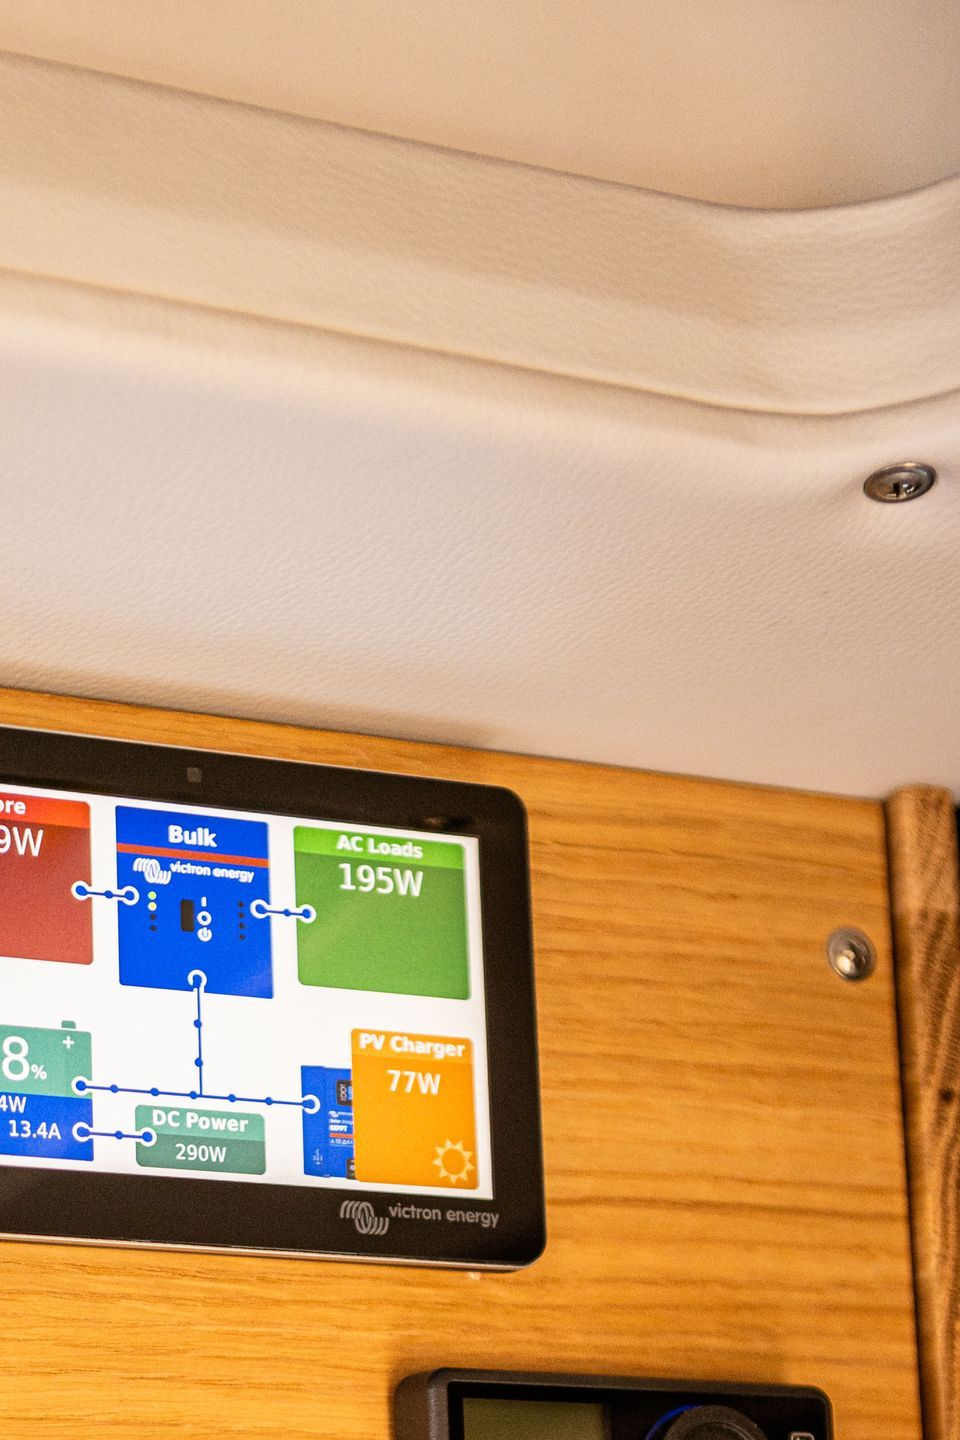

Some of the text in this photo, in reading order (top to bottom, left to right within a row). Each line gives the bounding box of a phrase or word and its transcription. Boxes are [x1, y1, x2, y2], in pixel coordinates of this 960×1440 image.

[168, 824, 218, 848] Bulk
[336, 834, 424, 859] AC Loads
[169, 861, 255, 884] victron energy
[338, 863, 424, 897] 195W
[358, 1033, 466, 1060] PV Charger
[386, 1069, 442, 1096] 77W
[8, 1119, 62, 1140] 13.4A
[151, 1109, 249, 1133] DC Power
[175, 1143, 227, 1163] 290W
[388, 1202, 500, 1229] victron energy
